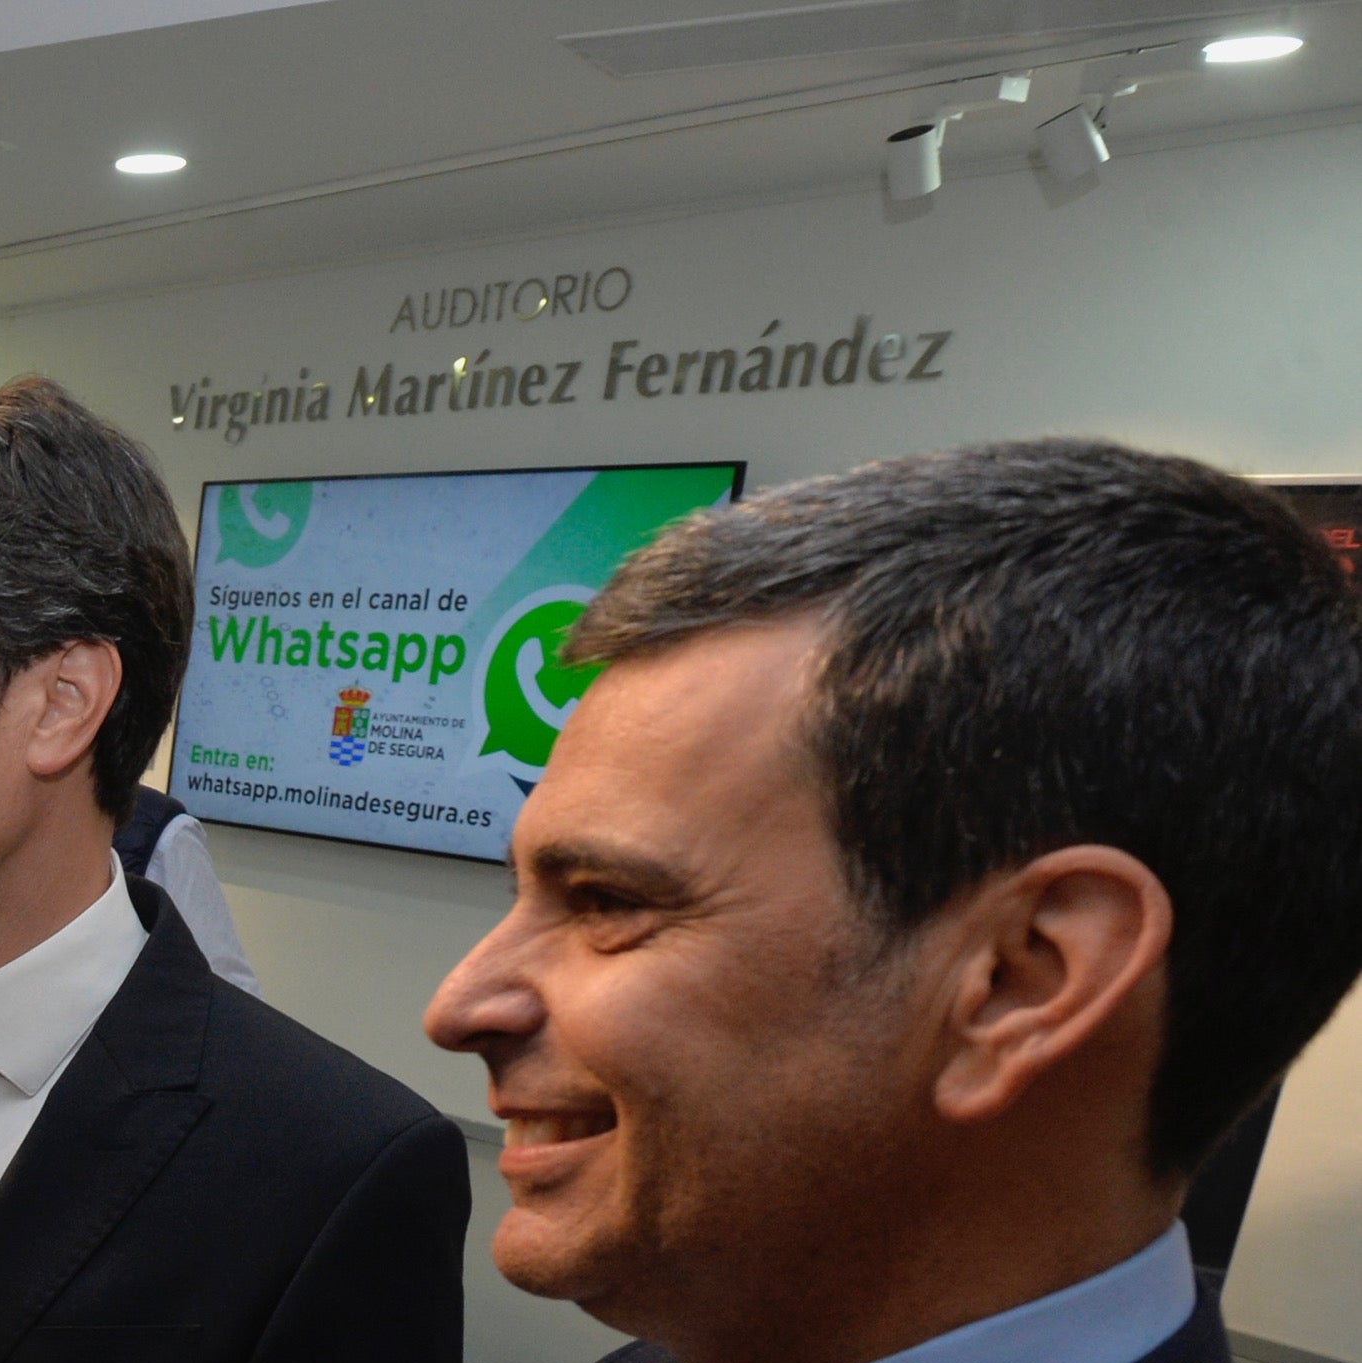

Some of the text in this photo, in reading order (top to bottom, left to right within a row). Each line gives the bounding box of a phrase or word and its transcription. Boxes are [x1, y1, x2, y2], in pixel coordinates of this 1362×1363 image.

[389, 266, 633, 333] AUDITORIO
[168, 313, 953, 446] Virginia Martínez Fernández
[209, 585, 469, 612] Síguenos en el canal de
[208, 614, 467, 686] Whatsapp
[369, 724, 424, 741] MOLINA
[372, 712, 467, 729] AYUNTAMIENTO DE
[190, 744, 275, 772] Entra en:
[367, 741, 445, 760] DE SEGURA
[187, 772, 492, 828] whatsapp.molinadesegura.es
